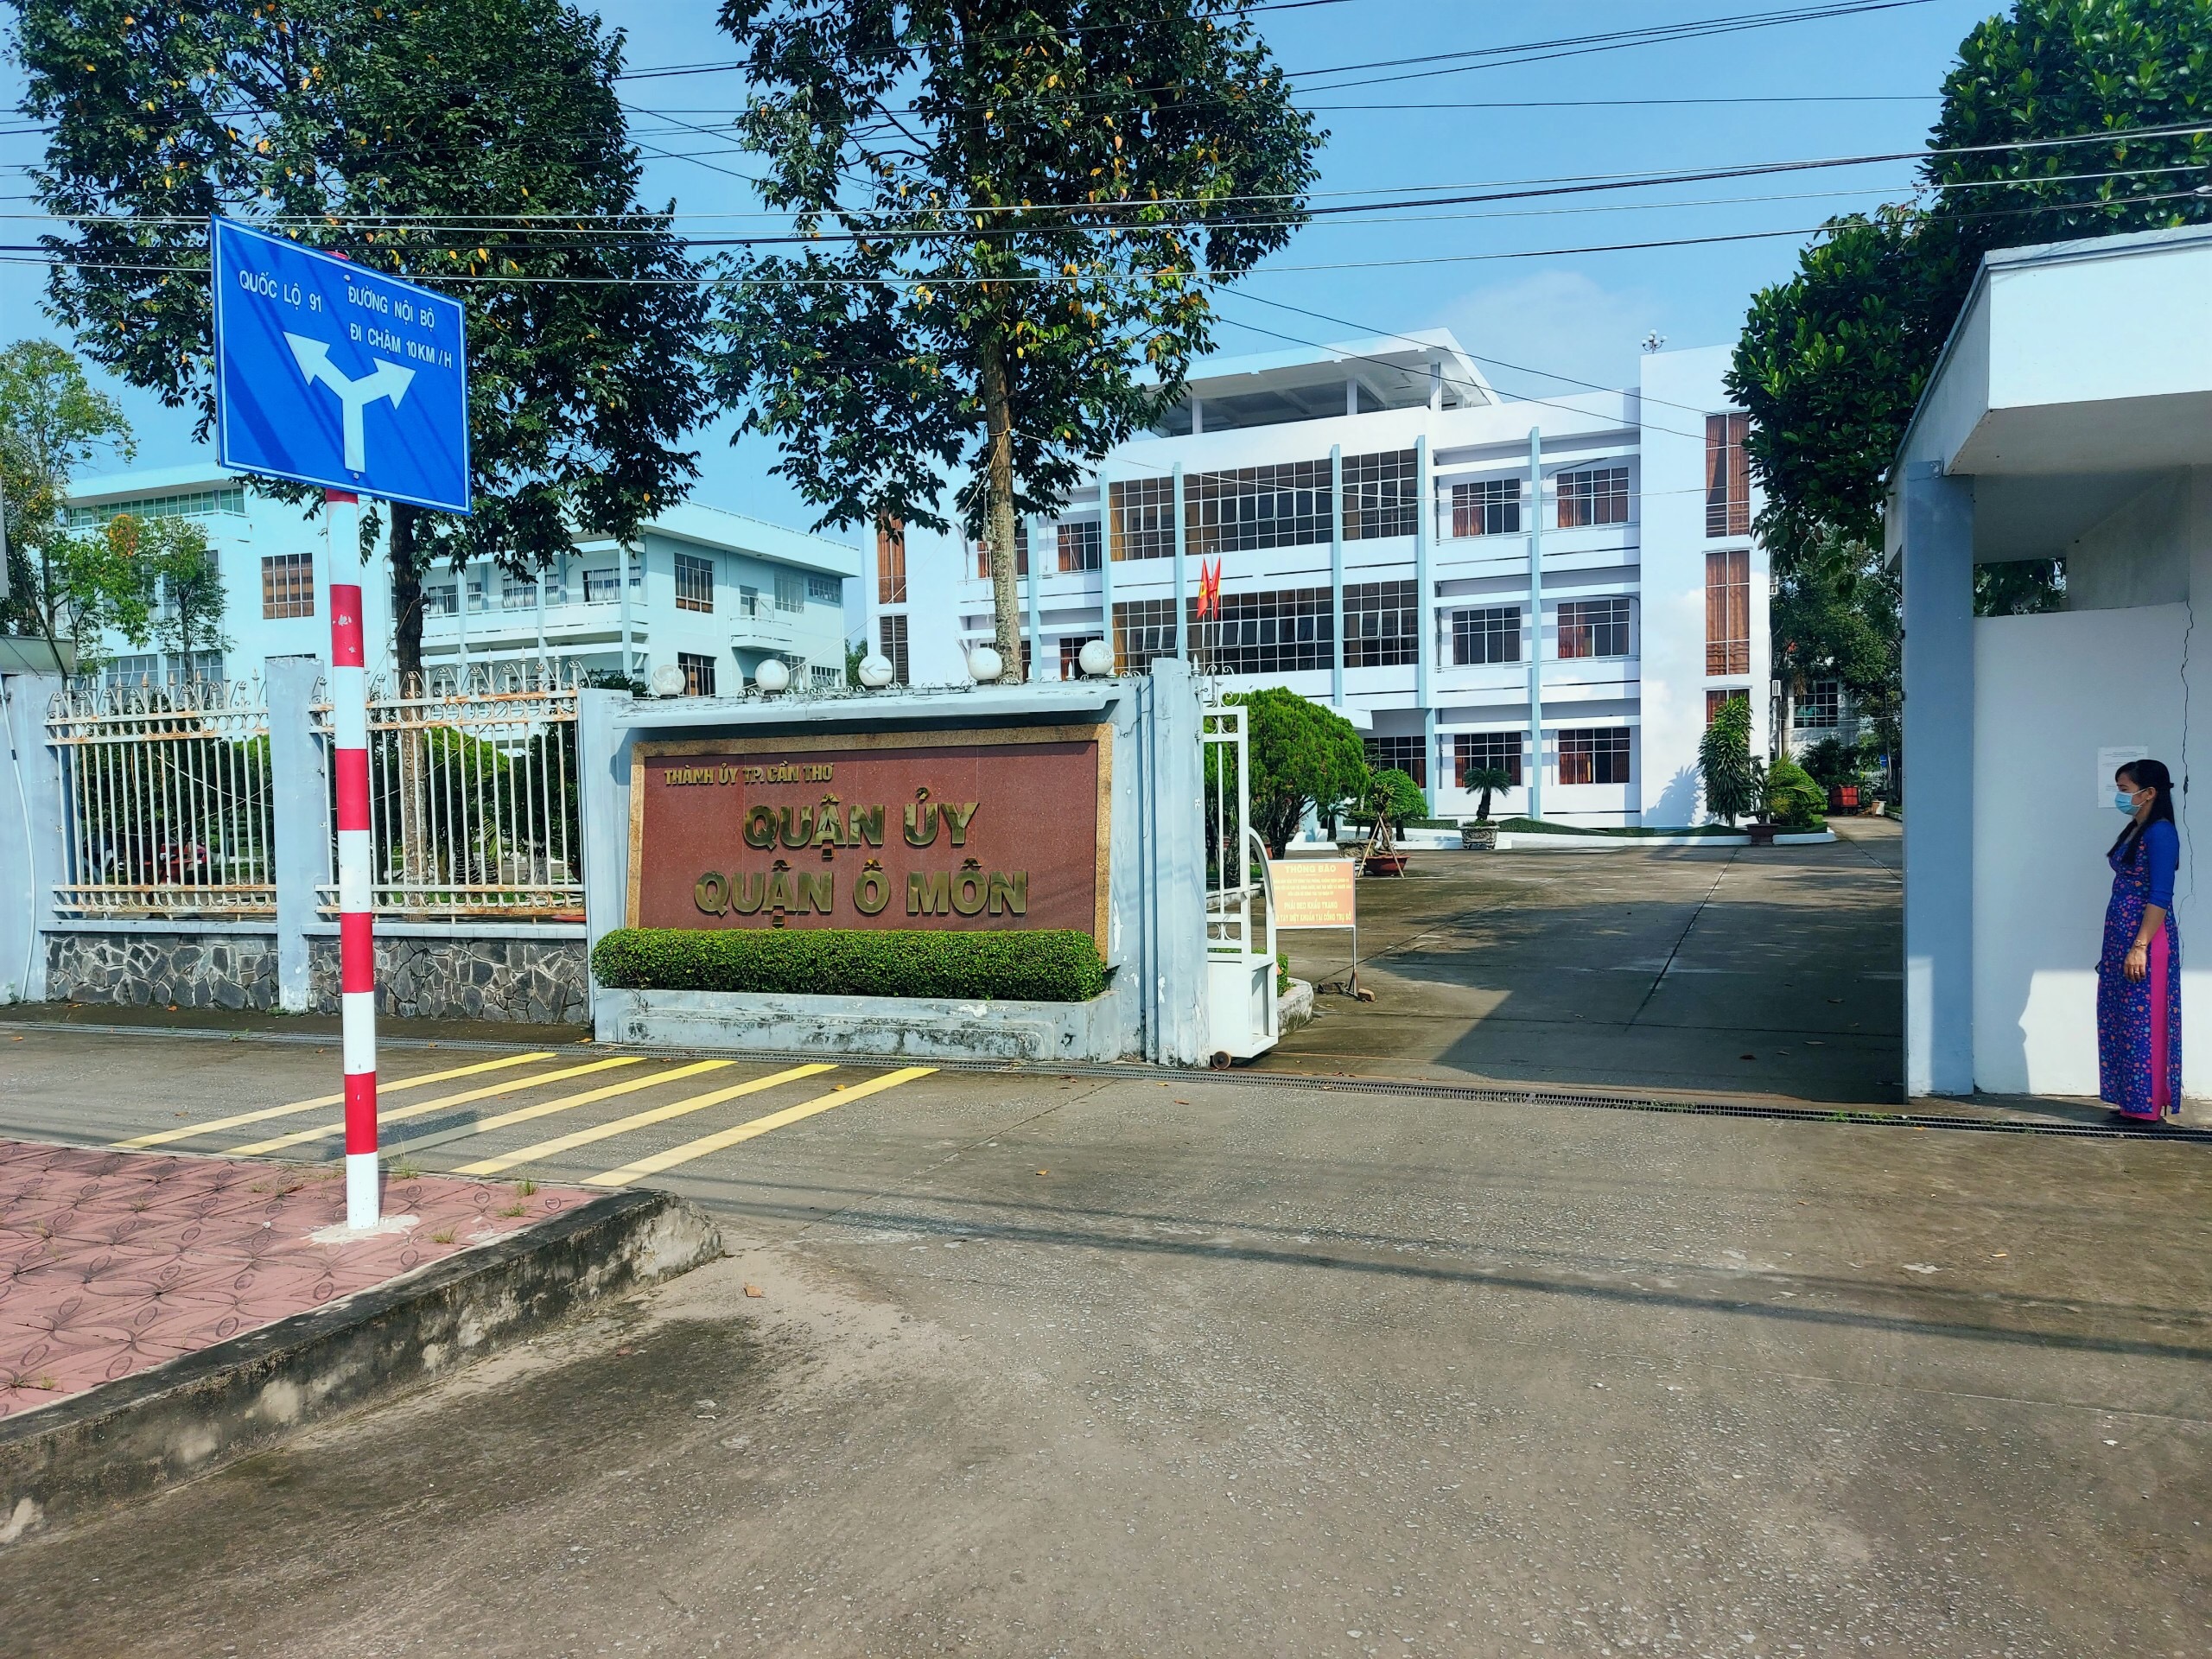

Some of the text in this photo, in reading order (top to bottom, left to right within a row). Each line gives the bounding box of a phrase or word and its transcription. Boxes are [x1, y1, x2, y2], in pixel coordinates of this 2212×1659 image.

[238, 270, 321, 313] QUỐC LỘ 91
[347, 284, 435, 333] ĐƯỜNG NỘI BỘ
[349, 322, 362, 342] ĐI
[367, 328, 401, 354] CHẬM
[664, 764, 715, 785] THÀNH
[718, 762, 740, 785] ỦY
[766, 760, 800, 784] CẦN
[803, 762, 835, 783] THƠ
[742, 786, 981, 861] QUẬN ỦY
[1284, 864, 1337, 874] THÔNG BÁO
[694, 857, 1029, 928] QUẬN Ô MÔN
[1322, 900, 1338, 909] TRANG
